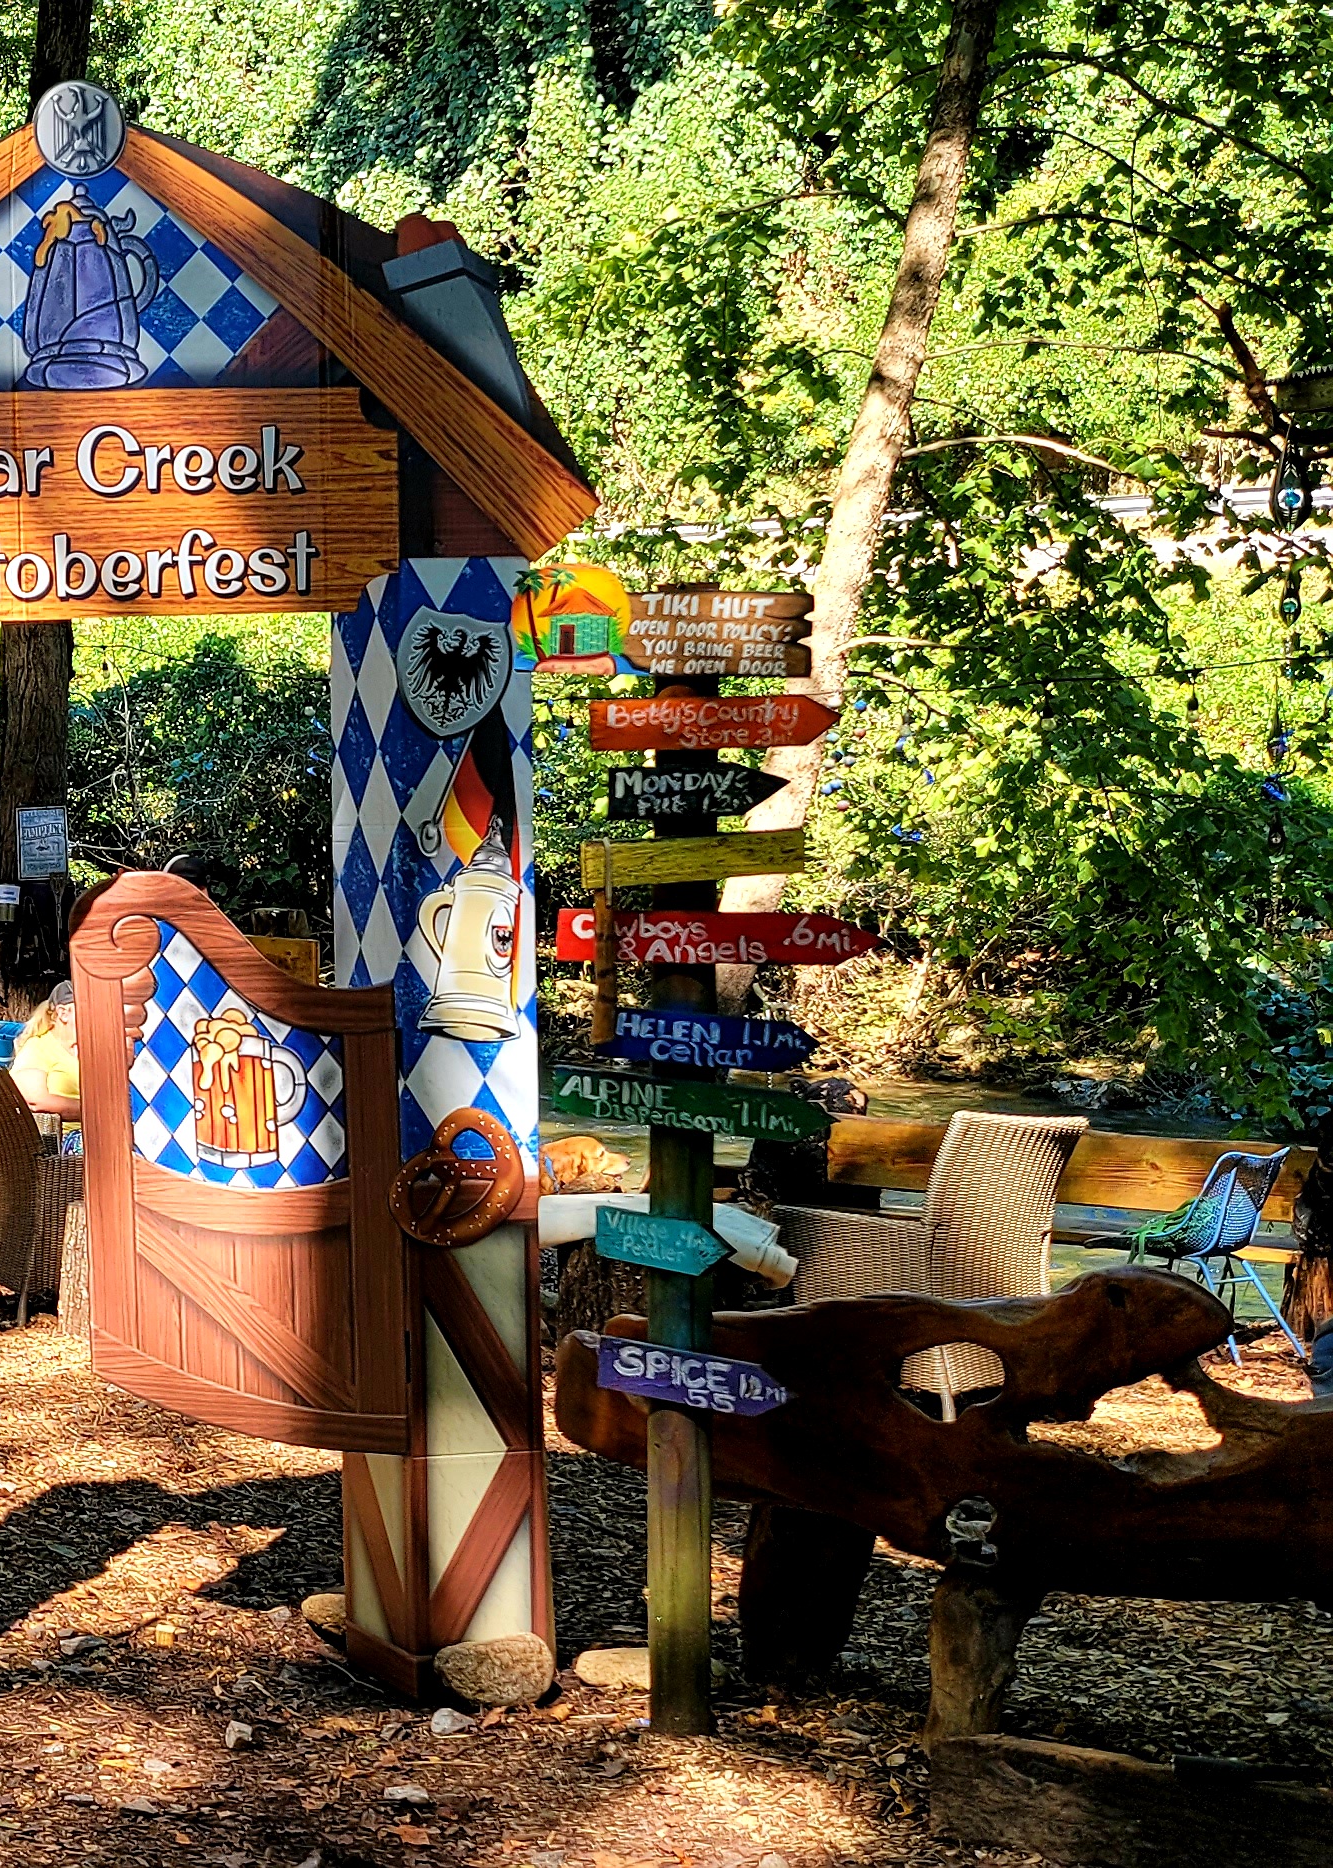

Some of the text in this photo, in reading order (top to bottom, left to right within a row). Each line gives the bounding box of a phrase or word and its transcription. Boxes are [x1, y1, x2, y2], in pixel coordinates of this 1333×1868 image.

[76, 424, 305, 499] Creek
[641, 593, 774, 619] TIKI HUT
[629, 620, 670, 636] OPEN
[675, 621, 718, 638] DOOR
[642, 638, 786, 659] YOU BRING BEER
[650, 658, 787, 676] WE OPEN DOOR
[696, 698, 799, 730] Country
[679, 726, 750, 748] Store
[571, 913, 709, 946] Cwboys
[616, 935, 769, 964] & Angels
[615, 1012, 721, 1045] HELEN
[649, 1039, 753, 1068] Cellar
[559, 1074, 676, 1110] ALPINE
[613, 1345, 733, 1394] SPICE
[684, 1388, 736, 1413] 55
